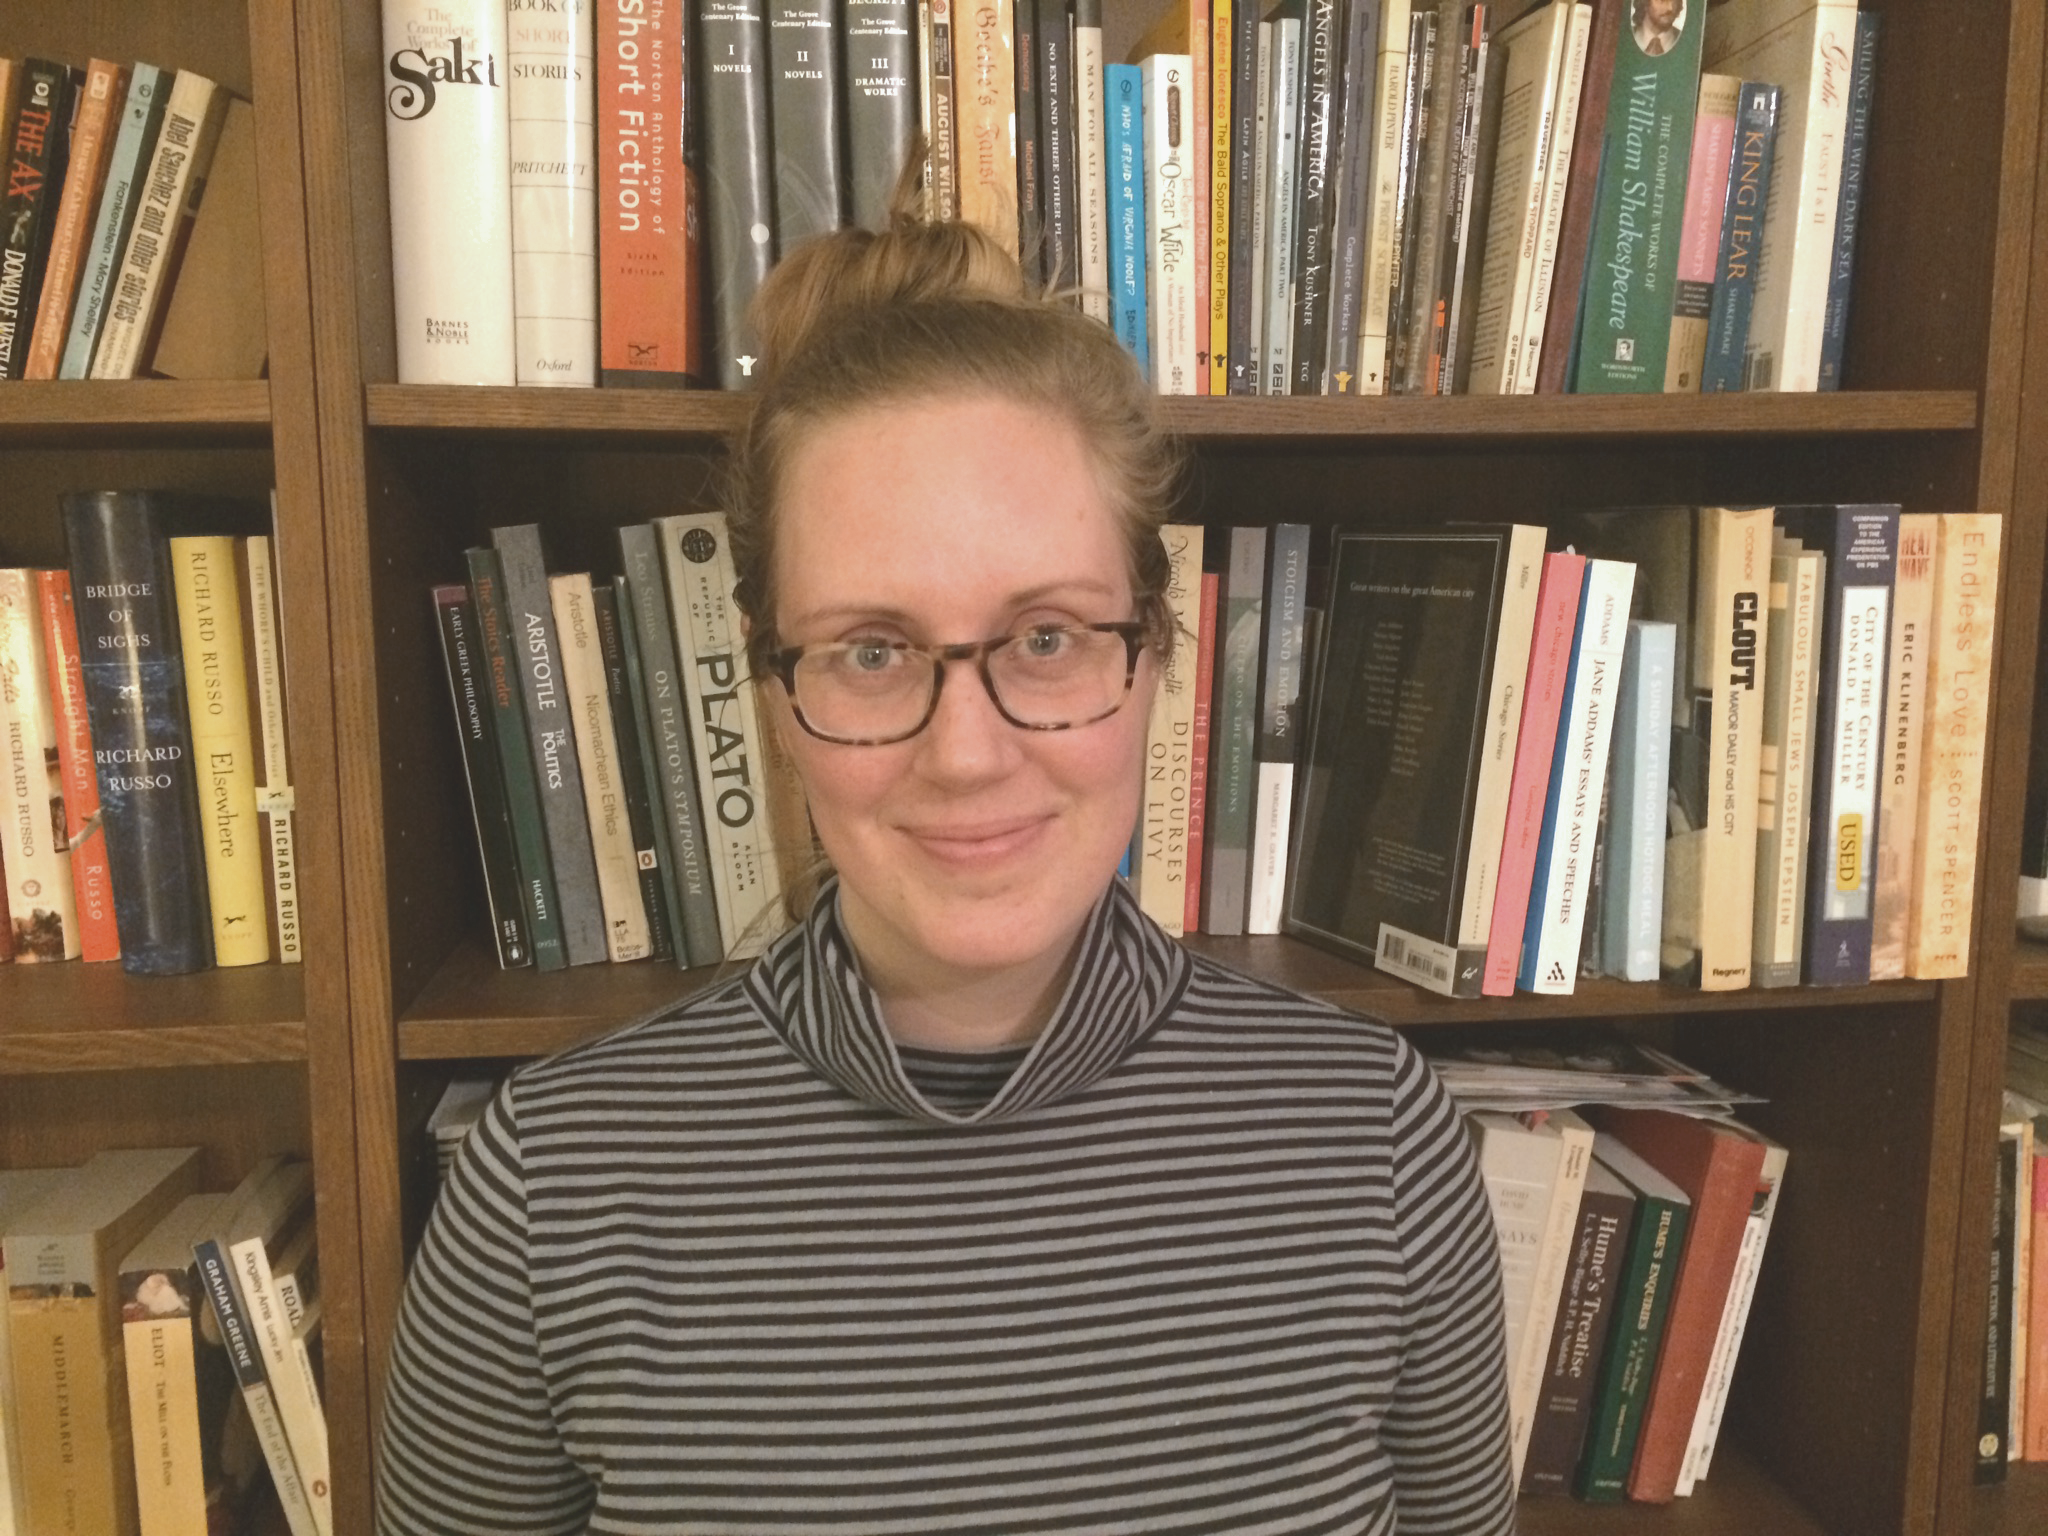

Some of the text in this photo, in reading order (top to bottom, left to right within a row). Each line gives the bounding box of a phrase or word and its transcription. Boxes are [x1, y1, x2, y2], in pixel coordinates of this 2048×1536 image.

[389, 36, 500, 121] Saki
[713, 65, 752, 73] NOVELS
[728, 45, 735, 55] I
[784, 71, 823, 79] NOVELS
[797, 51, 809, 62] II
[855, 77, 906, 87] DRAMATIC
[863, 87, 899, 97] WORKS
[871, 58, 889, 69] III
[7, 108, 50, 203] THE AX
[617, 0, 648, 230] Short Fiction
[650, 0, 665, 235] The Norton Anthology of
[935, 93, 950, 160] AUGUST
[1046, 41, 1063, 219] NO EXIT AND THREE OTHER
[1084, 46, 1098, 264] A MAN FOR ALL SEASONS
[1303, 0, 1334, 325] ANGELS IN AMERICA TONY KUSHNER
[1837, 29, 1877, 281] SAILING THE WINE-DARK SEA
[1158, 162, 1182, 218] Oscar
[1212, 17, 1228, 320] Eugène Ionesco The Bald Soprano & Other Plays
[1608, 72, 1657, 328] William Shakespeare
[1643, 113, 1671, 291] THE COMPLETE WORKS OF
[1737, 131, 1764, 205] KING
[82, 180, 129, 337] Frankenstein Mary Shelley
[114, 114, 195, 324] Abel Sanchez and other stories
[1159, 223, 1183, 272] Wilde
[1532, 148, 1569, 313] THE THEATRE OF ILLUSION
[1726, 214, 1753, 279] LEAR
[426, 318, 469, 329] BARNES
[536, 358, 573, 372] Oxford
[1719, 287, 1737, 357] SHAKESPEARE
[1300, 361, 1310, 382] TCG
[86, 583, 152, 598] BRIDGE
[108, 609, 134, 623] OF
[1517, 563, 1530, 590] Miller
[98, 634, 151, 649] SIGHS
[451, 607, 483, 740] EARLY GREEK PHILOSOPHY
[478, 578, 511, 707] The Stoics Reader
[525, 611, 556, 708] ARISTOTLE
[1272, 548, 1298, 738] STOICISM AND EMOTION
[1591, 660, 1605, 692] JANE
[1730, 591, 1758, 690] CLOUT
[1949, 530, 1984, 738] Endless Love
[191, 551, 236, 859] RICHARD RUSSO Elsewhere
[554, 727, 566, 746] THE
[567, 592, 617, 836] Aristotle Nicomachean Ethics
[697, 653, 755, 828] PLATO
[1495, 684, 1513, 761] Chicago Stories
[1855, 605, 1877, 789] CITY OF THE CENTURY
[1894, 622, 1914, 784] ERIC KLINENBERG
[7, 720, 35, 858] RICHARD RUSSO
[63, 654, 103, 922] Straight Man Russo
[95, 745, 182, 764] RICHARD
[109, 774, 172, 791] RUSSO
[540, 730, 561, 790] POLITICS
[654, 670, 701, 897] ON PLATO'S SYMPOSIUM
[1188, 702, 1207, 837] THE PRINCE
[1575, 768, 1590, 817] ESSAYS
[1722, 689, 1739, 836] MAYOR DALEY and HIS CITY
[1780, 573, 1811, 925] FABULOUS SMALL JEWS JOSEPH EPSTEIN
[1146, 742, 1167, 860] ON LIVY
[1166, 721, 1188, 881] DISCOURSES
[1569, 824, 1581, 853] AND
[273, 818, 291, 890] RICHARD
[530, 878, 547, 921] HACKETT
[1557, 858, 1576, 923] SPEECHES
[1839, 823, 1856, 881] USED
[1937, 768, 1962, 937] SCOTT SPENCER
[280, 898, 296, 952] RUSSO
[1712, 967, 1746, 978] Regnery
[206, 1258, 251, 1368] GRAHAM GREENE
[244, 1251, 272, 1321] Kingsley Amis
[1571, 1216, 1617, 1379] Hume's Treatise
[1637, 1209, 1673, 1331] HUME'S ENQUIRIES
[49, 1333, 72, 1463] MIDDLEMARCH
